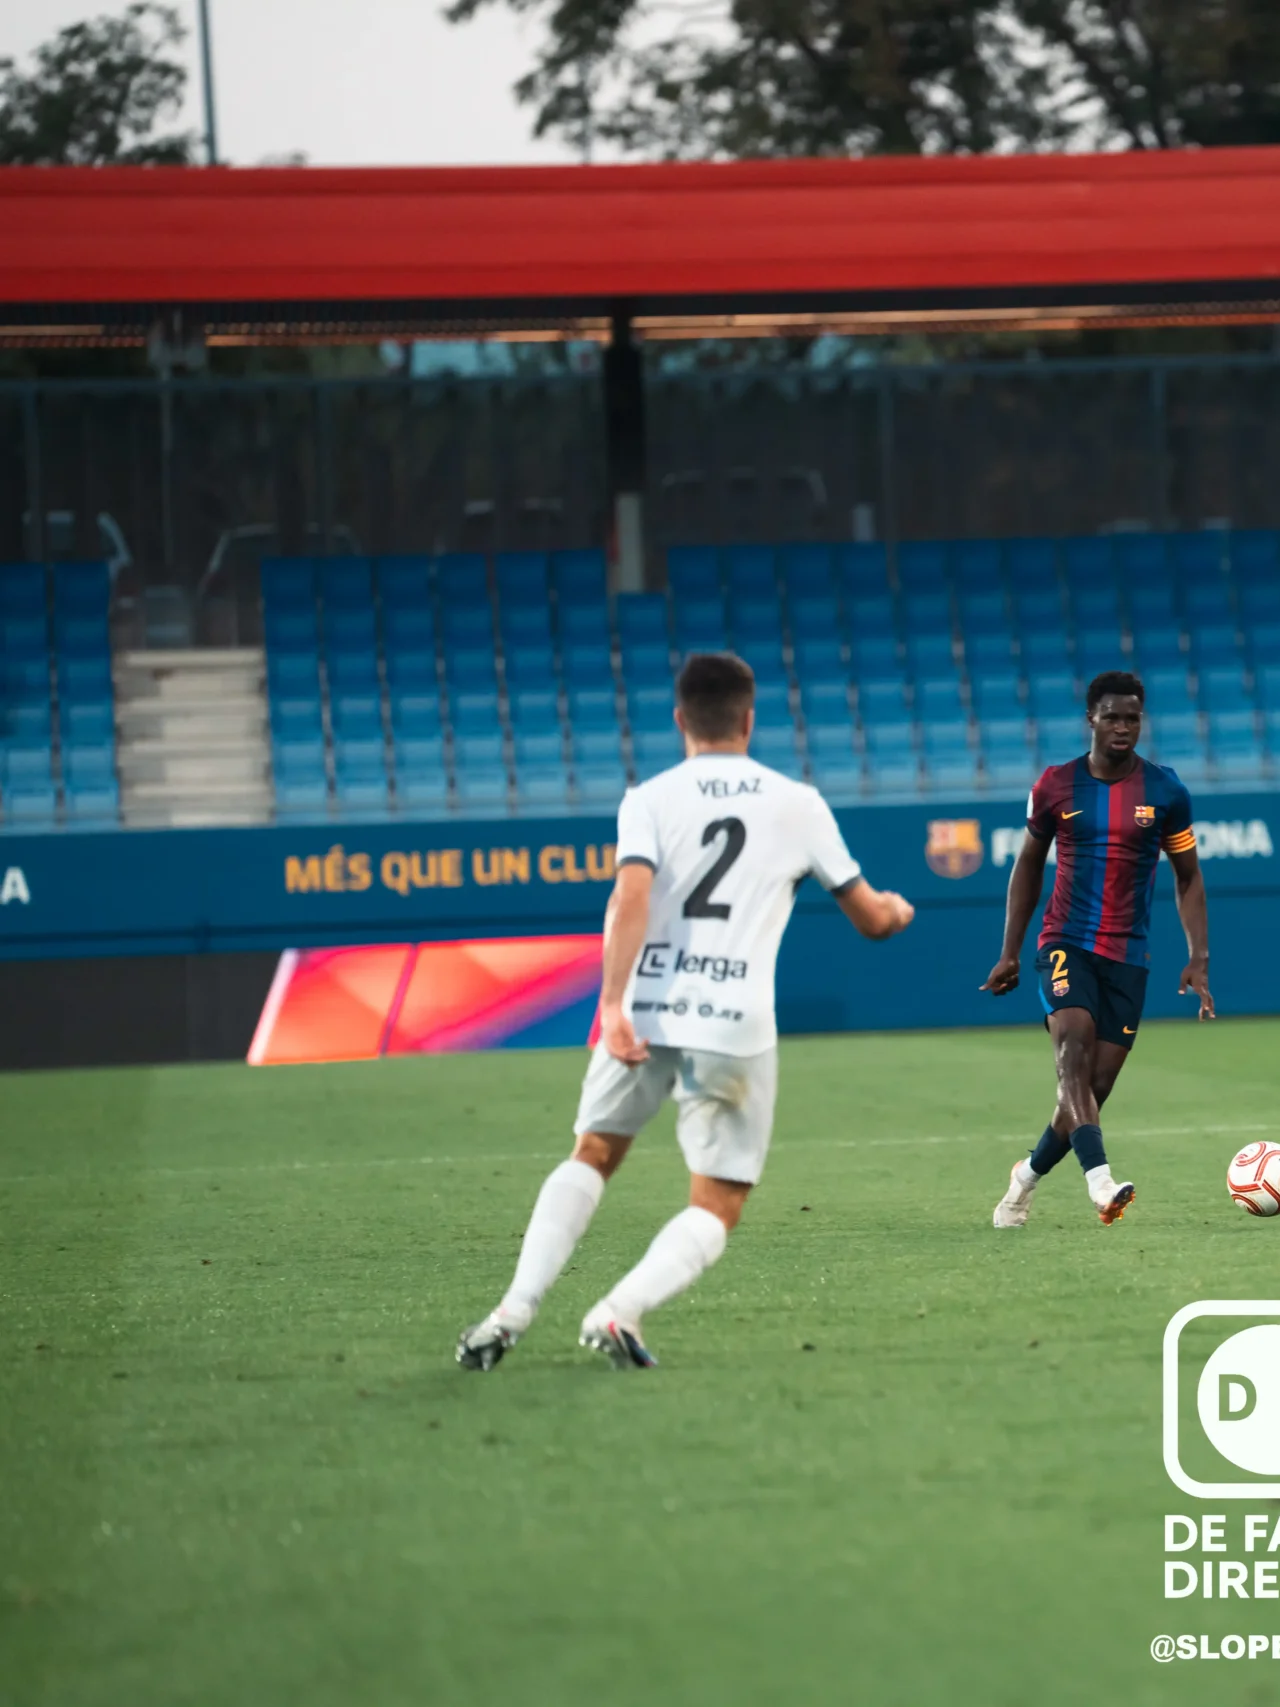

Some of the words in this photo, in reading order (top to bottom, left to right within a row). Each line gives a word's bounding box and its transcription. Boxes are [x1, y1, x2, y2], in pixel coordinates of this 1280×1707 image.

[285, 844, 373, 893] MÉS
[381, 850, 463, 896] QUE
[472, 847, 530, 886] UN
[539, 844, 618, 883] CLU
[682, 816, 747, 921] 2
[675, 949, 748, 983] lerga
[1050, 950, 1069, 980] 2
